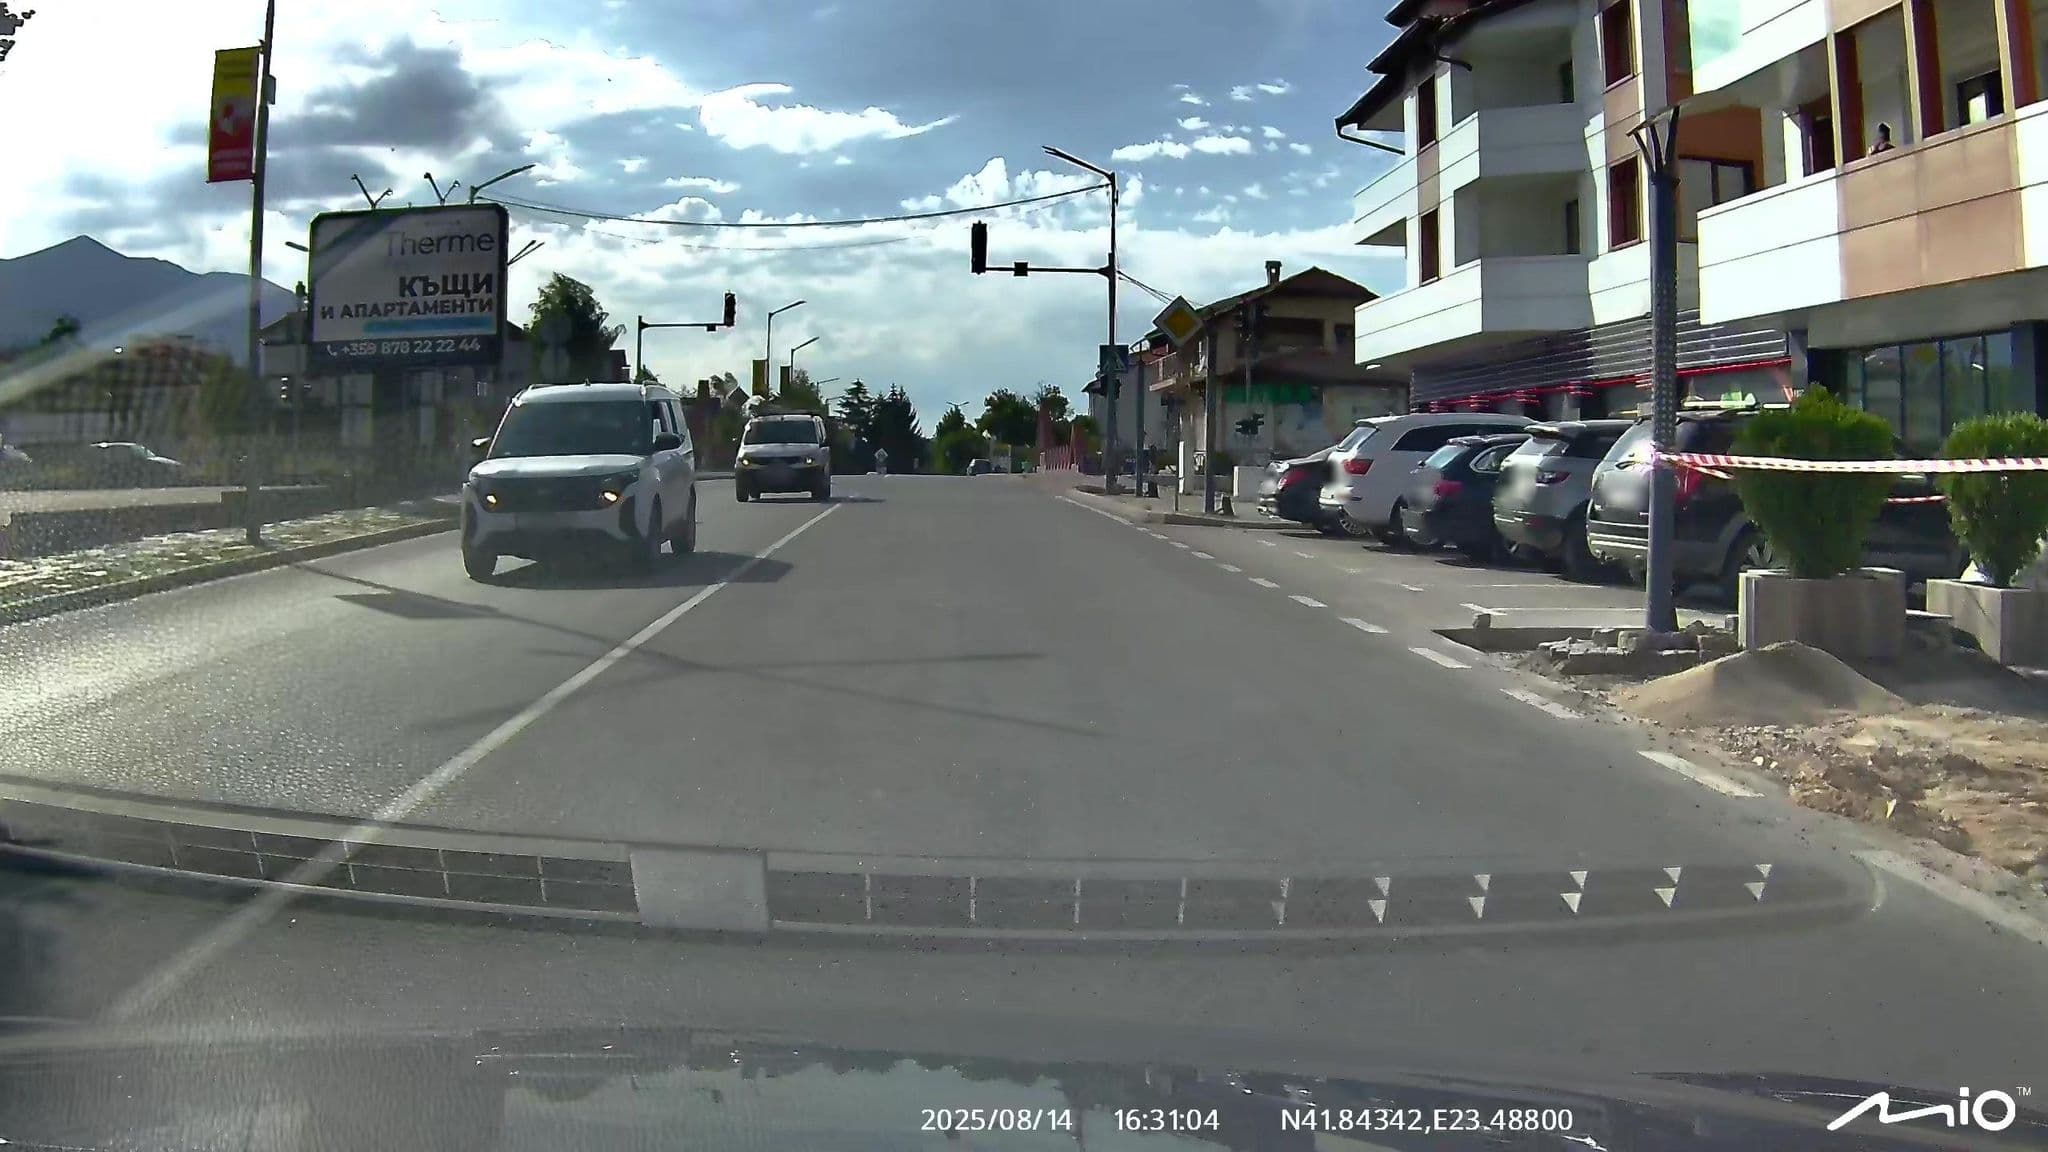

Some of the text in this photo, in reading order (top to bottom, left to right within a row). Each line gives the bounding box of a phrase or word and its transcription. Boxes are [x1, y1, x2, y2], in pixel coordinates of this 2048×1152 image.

[387, 231, 495, 256] Therme
[400, 273, 493, 298] КЪЩИ
[321, 299, 493, 319] И АПАРТАМЕНТИ
[342, 342, 377, 355] +359
[414, 340, 433, 353] 22
[436, 339, 456, 352] 22
[458, 338, 481, 350] 44
